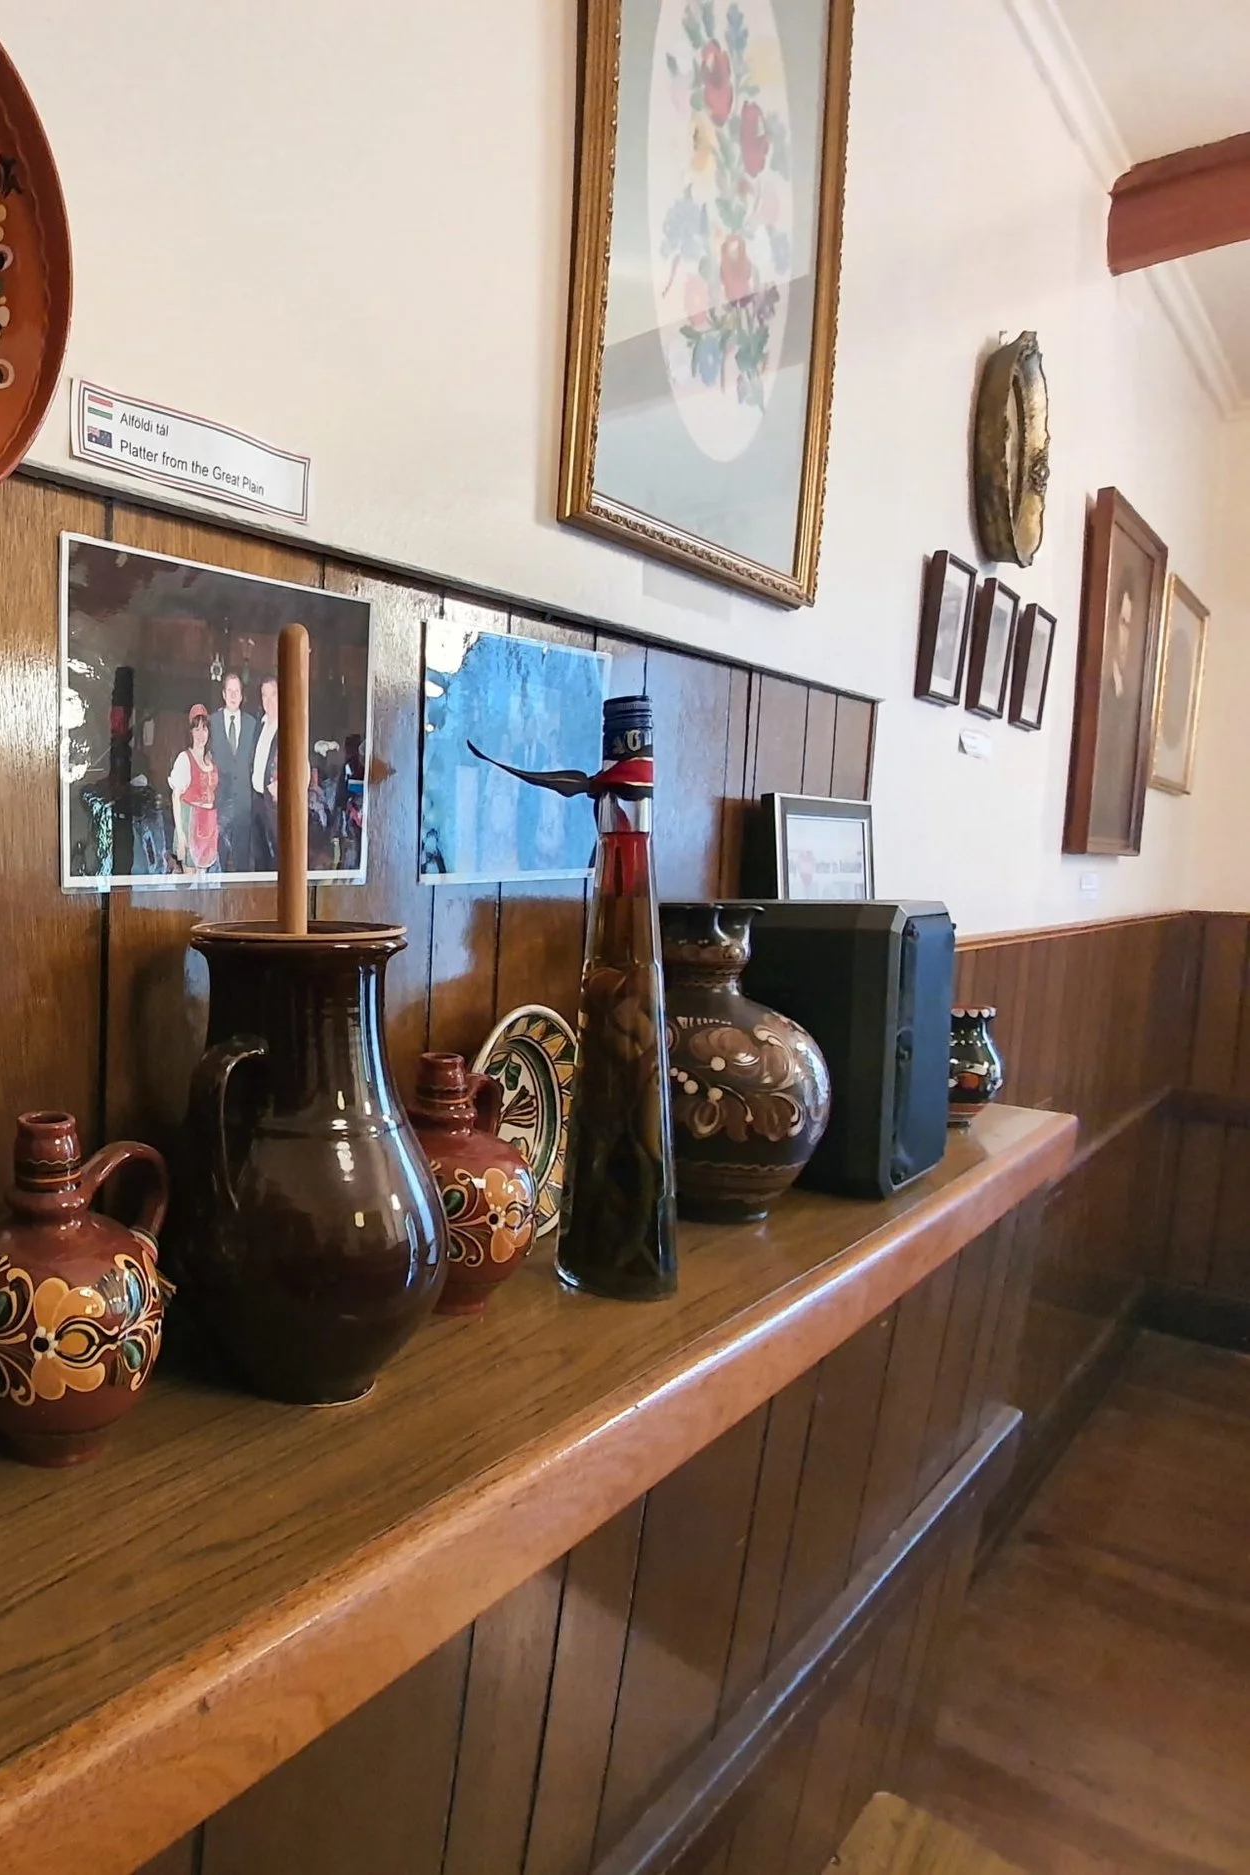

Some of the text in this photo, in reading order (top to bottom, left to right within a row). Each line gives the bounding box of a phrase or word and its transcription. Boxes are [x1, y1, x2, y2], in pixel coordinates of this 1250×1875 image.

[120, 412, 169, 437] Alföldi tál
[120, 439, 265, 497] Platter from the Great Plain
